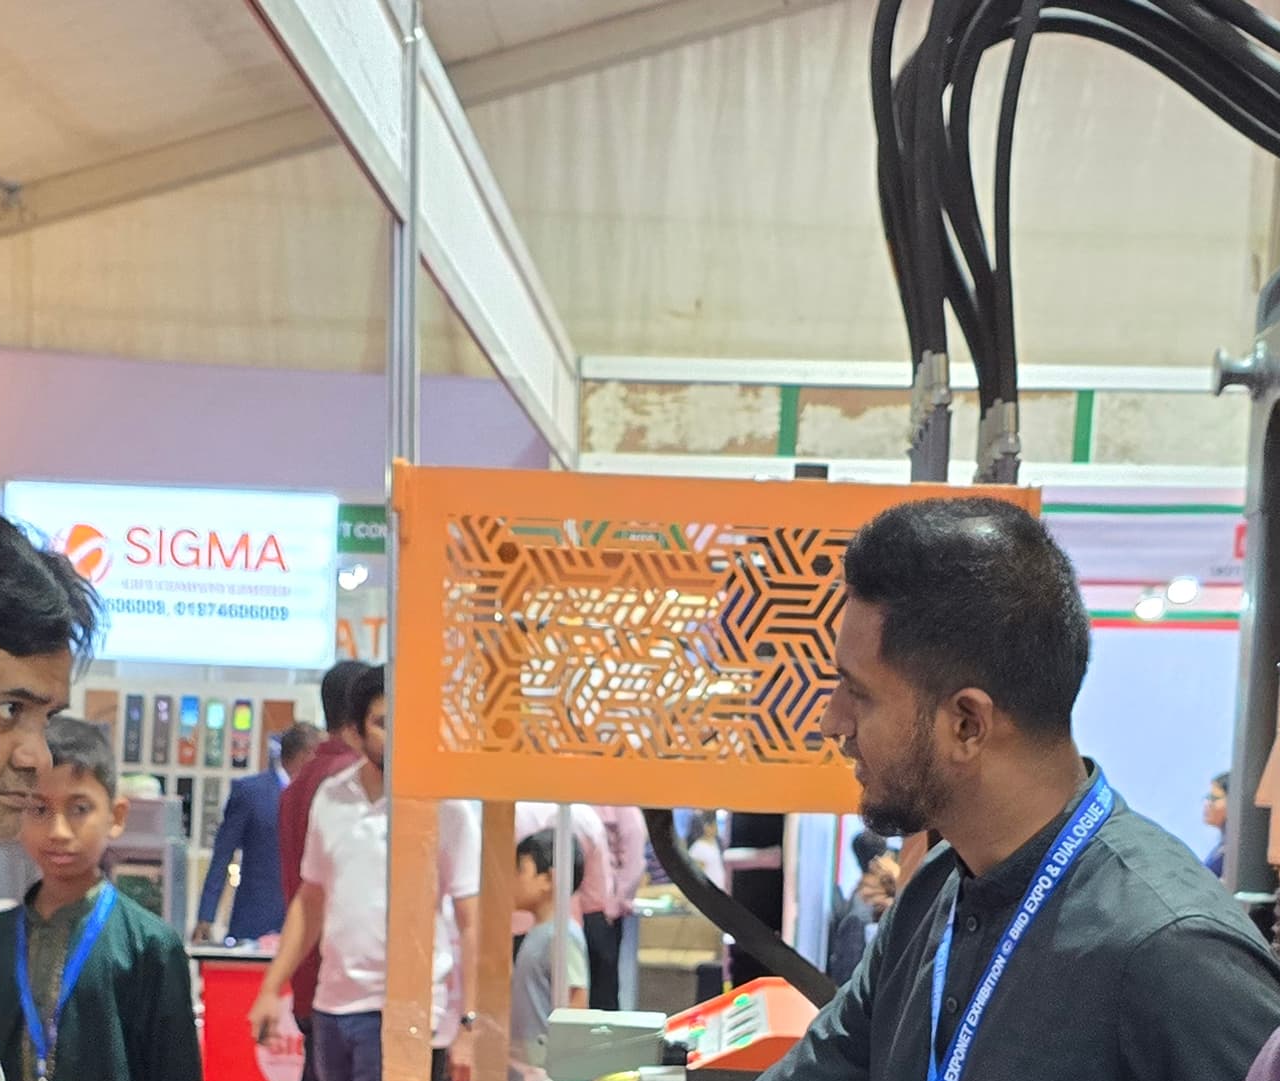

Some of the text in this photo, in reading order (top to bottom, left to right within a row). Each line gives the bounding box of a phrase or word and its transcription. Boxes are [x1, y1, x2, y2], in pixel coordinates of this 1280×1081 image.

[126, 526, 288, 572] SIGMA
[967, 953, 1008, 1026] EXHIBITION
[1009, 910, 1029, 942] BIID
[1024, 874, 1054, 913] EXPO
[1045, 862, 1061, 878] &
[1054, 801, 1105, 866] DIALOGUE
